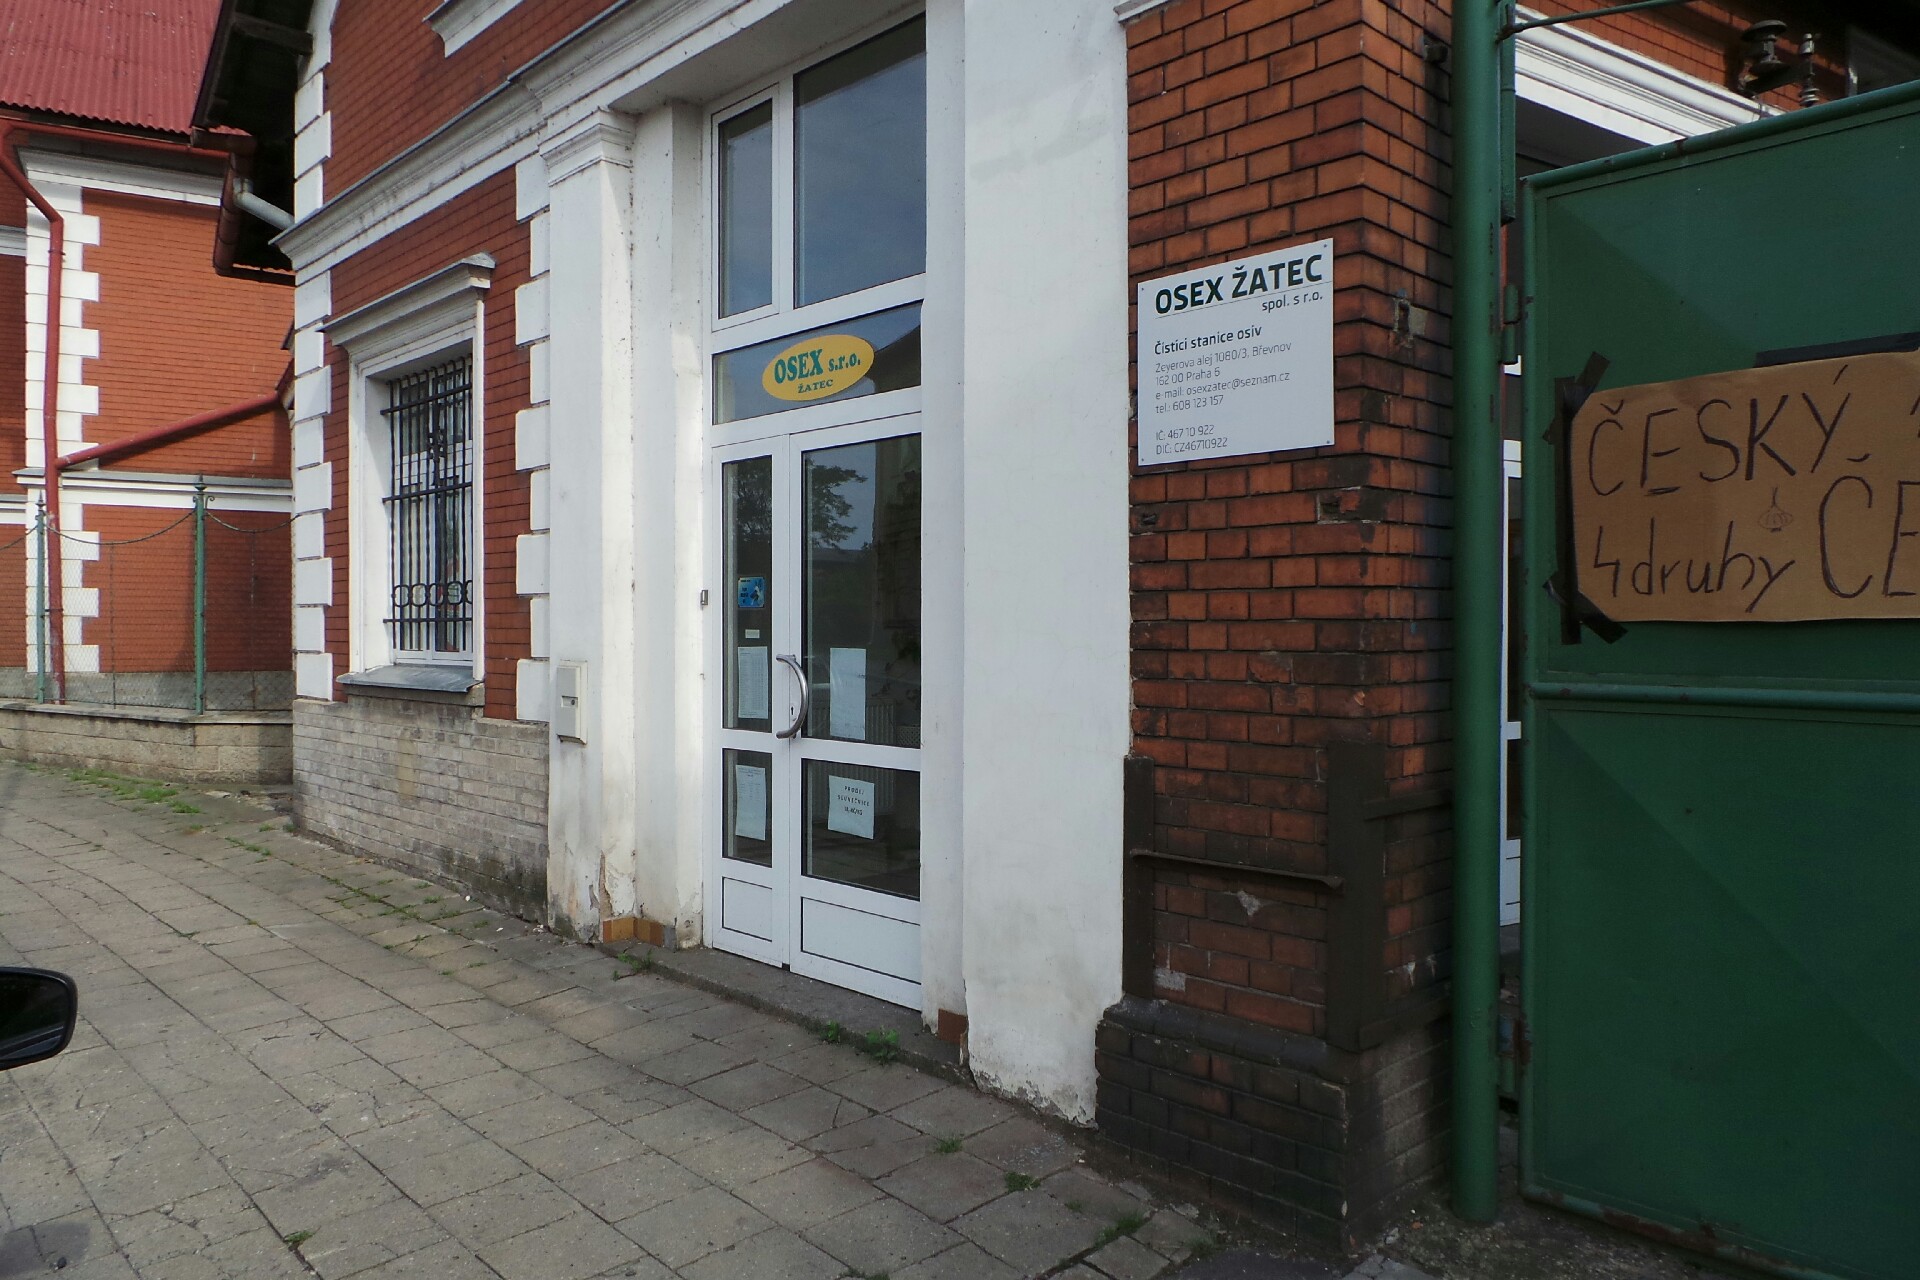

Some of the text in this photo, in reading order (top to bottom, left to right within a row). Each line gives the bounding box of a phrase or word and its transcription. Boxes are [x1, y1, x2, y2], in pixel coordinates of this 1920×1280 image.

[1155, 254, 1323, 314] OSEX ŽATEC
[1262, 291, 1323, 313] spol. s r.o.
[1190, 331, 1234, 349] stanice
[1237, 325, 1262, 340] osiv
[774, 348, 861, 384] OSEX s.r.o.
[1155, 362, 1195, 374] Zeyerova
[1197, 354, 1213, 367] alej
[1252, 342, 1292, 357] Břevnov
[797, 379, 834, 394] ŽATEC
[1156, 374, 1169, 387] 162
[1171, 372, 1184, 384] 00
[1186, 368, 1212, 381] Praha
[1186, 372, 1290, 396] osexzatec@seznam.cz
[1172, 399, 1191, 411] 608
[1193, 397, 1207, 408] 123
[1209, 394, 1224, 406] 157
[1167, 428, 1184, 440] 467
[1186, 426, 1196, 437] 10
[1197, 424, 1215, 436] 922
[1588, 364, 1850, 496] ČESKÝ
[1174, 437, 1228, 453] CZ46710922
